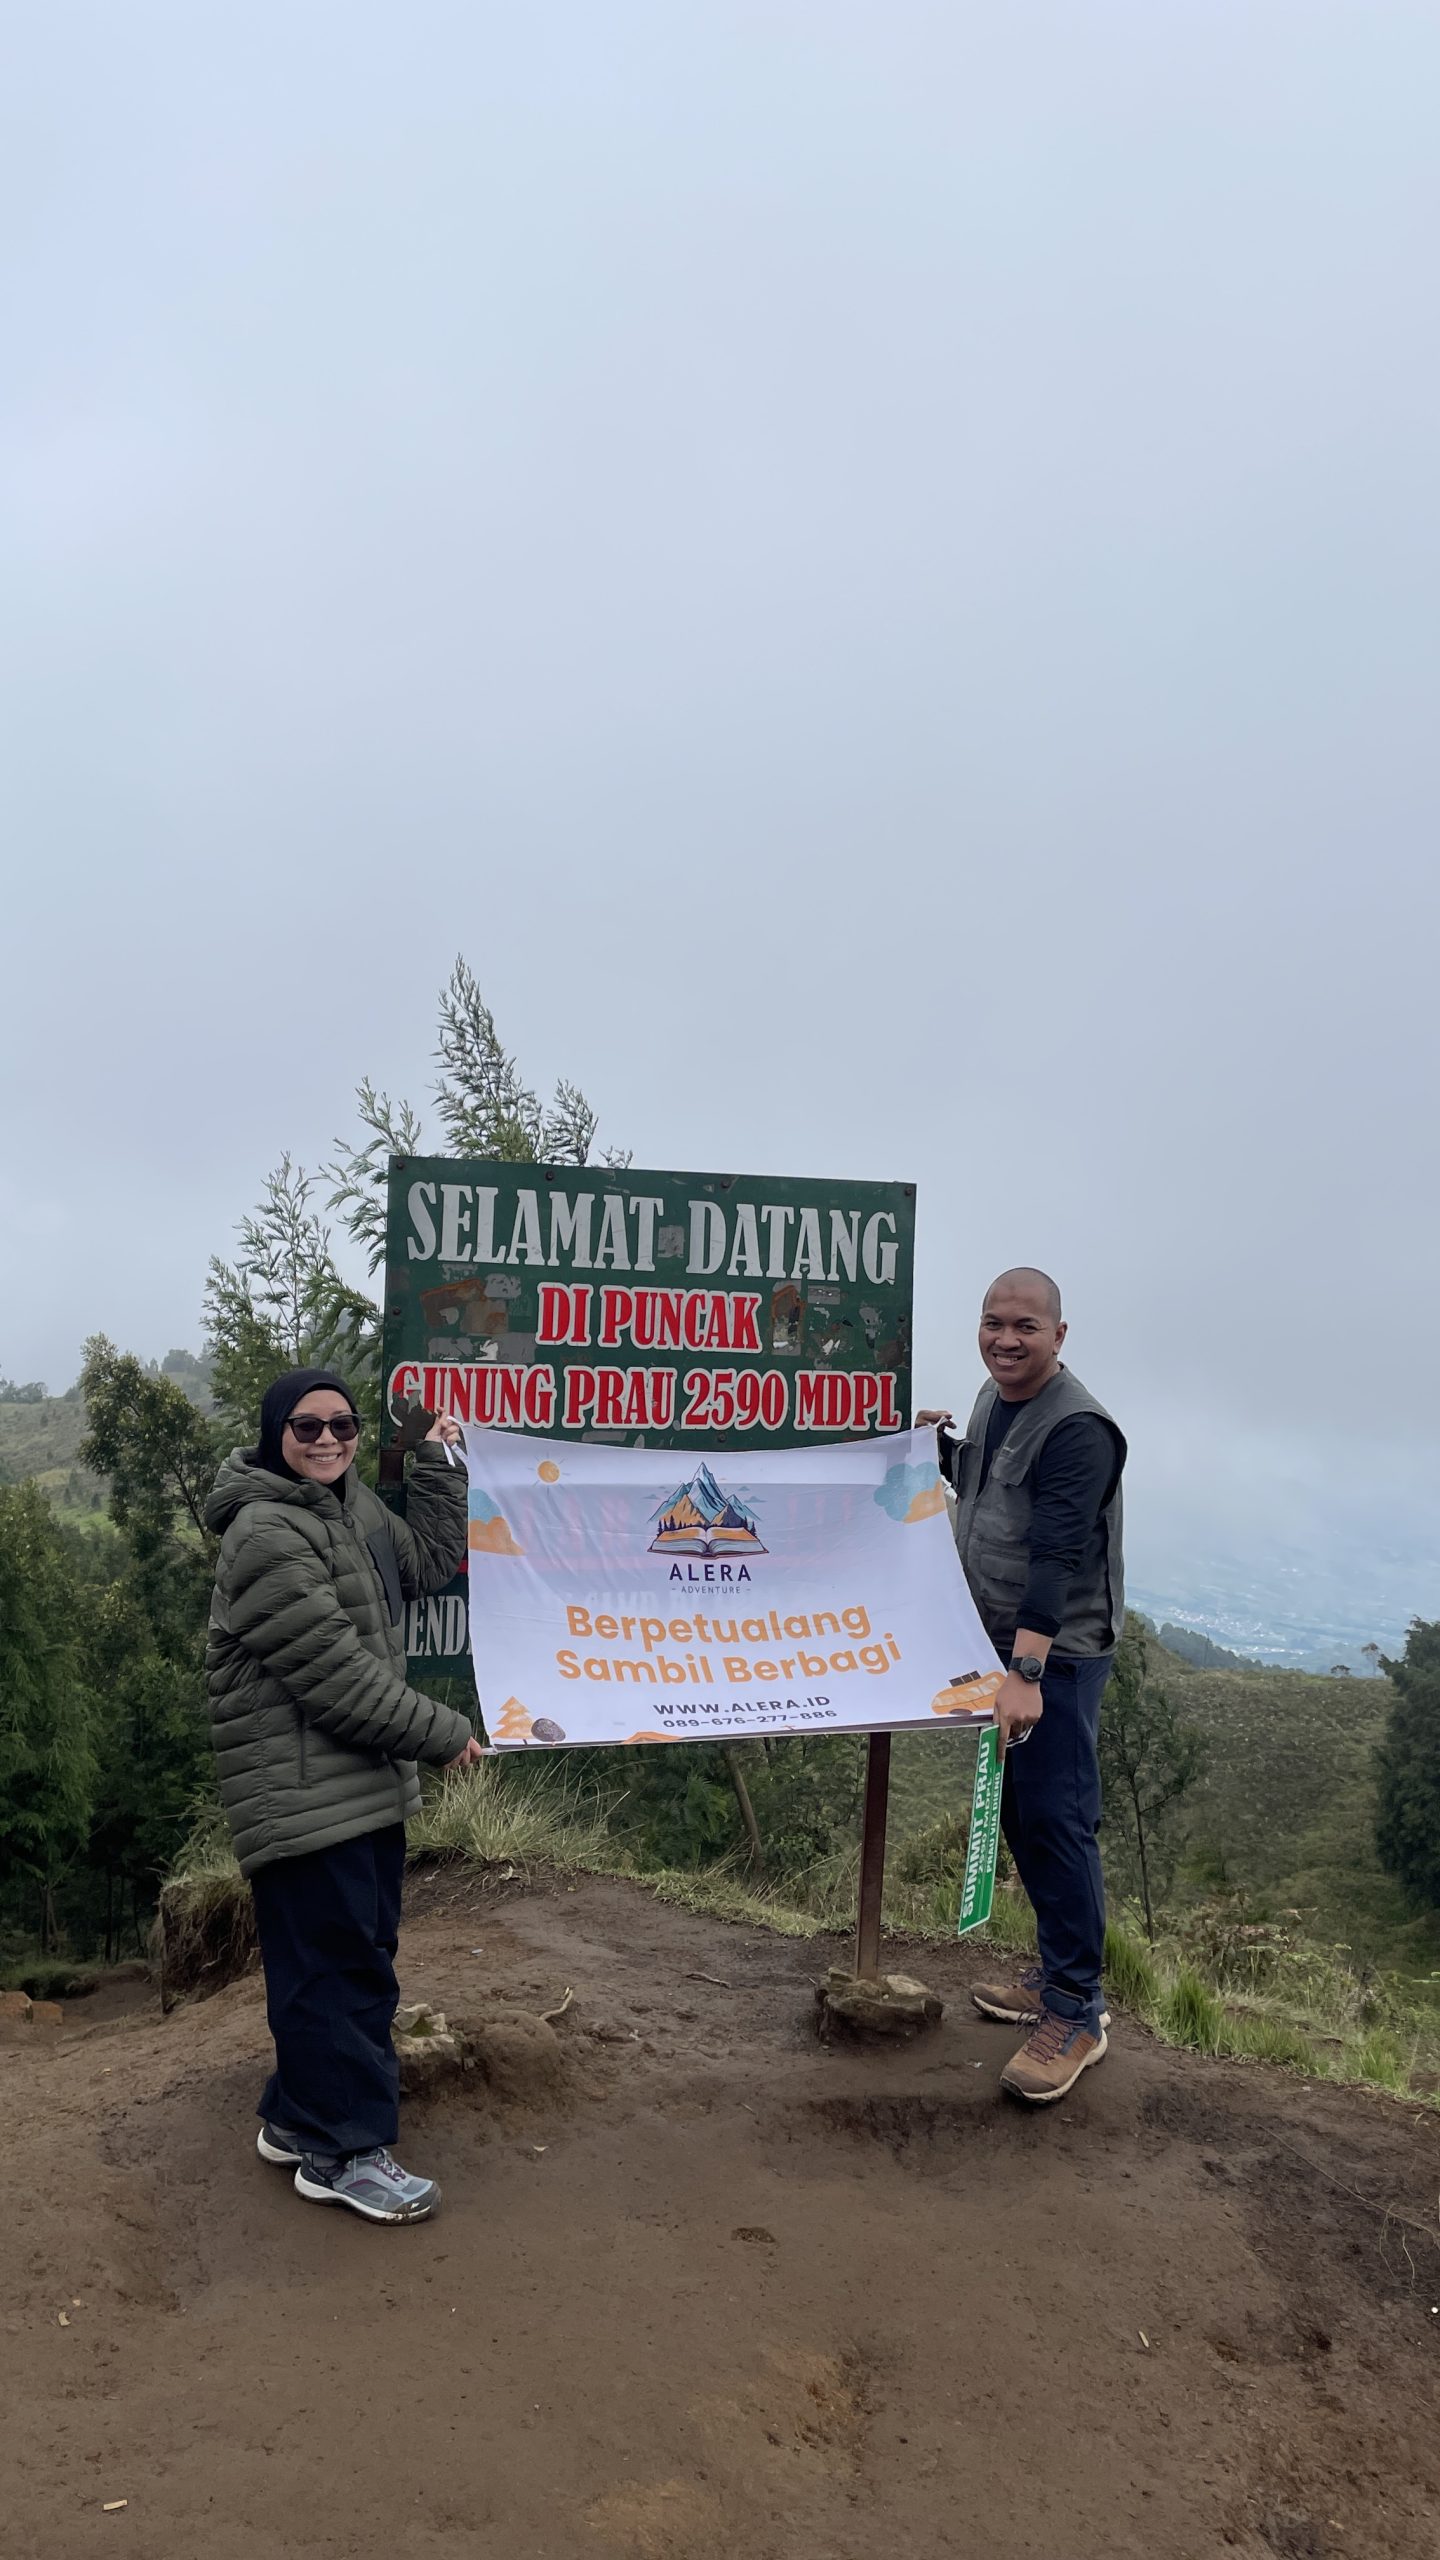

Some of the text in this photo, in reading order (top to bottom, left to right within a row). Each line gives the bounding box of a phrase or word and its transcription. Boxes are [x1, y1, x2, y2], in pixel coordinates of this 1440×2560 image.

[406, 1181, 899, 1285] SELAMAT DATANG
[536, 1282, 762, 1353] DI PUNCAK
[563, 1365, 677, 1430] PRAU
[682, 1366, 788, 1431] 2590
[795, 1371, 902, 1431] MDPL
[669, 1563, 752, 1582] ALERA
[681, 1585, 741, 1595] ADVENTURE
[566, 1605, 872, 1653] Berpetualang
[555, 1633, 902, 1684] Sambil Berbagi
[653, 1696, 831, 1715] WWW.ALERA.ID
[663, 1710, 838, 1728] 089-676-277-886
[963, 1742, 990, 1918] SUMMIT PRAU
[986, 1838, 995, 1874] PRAU
